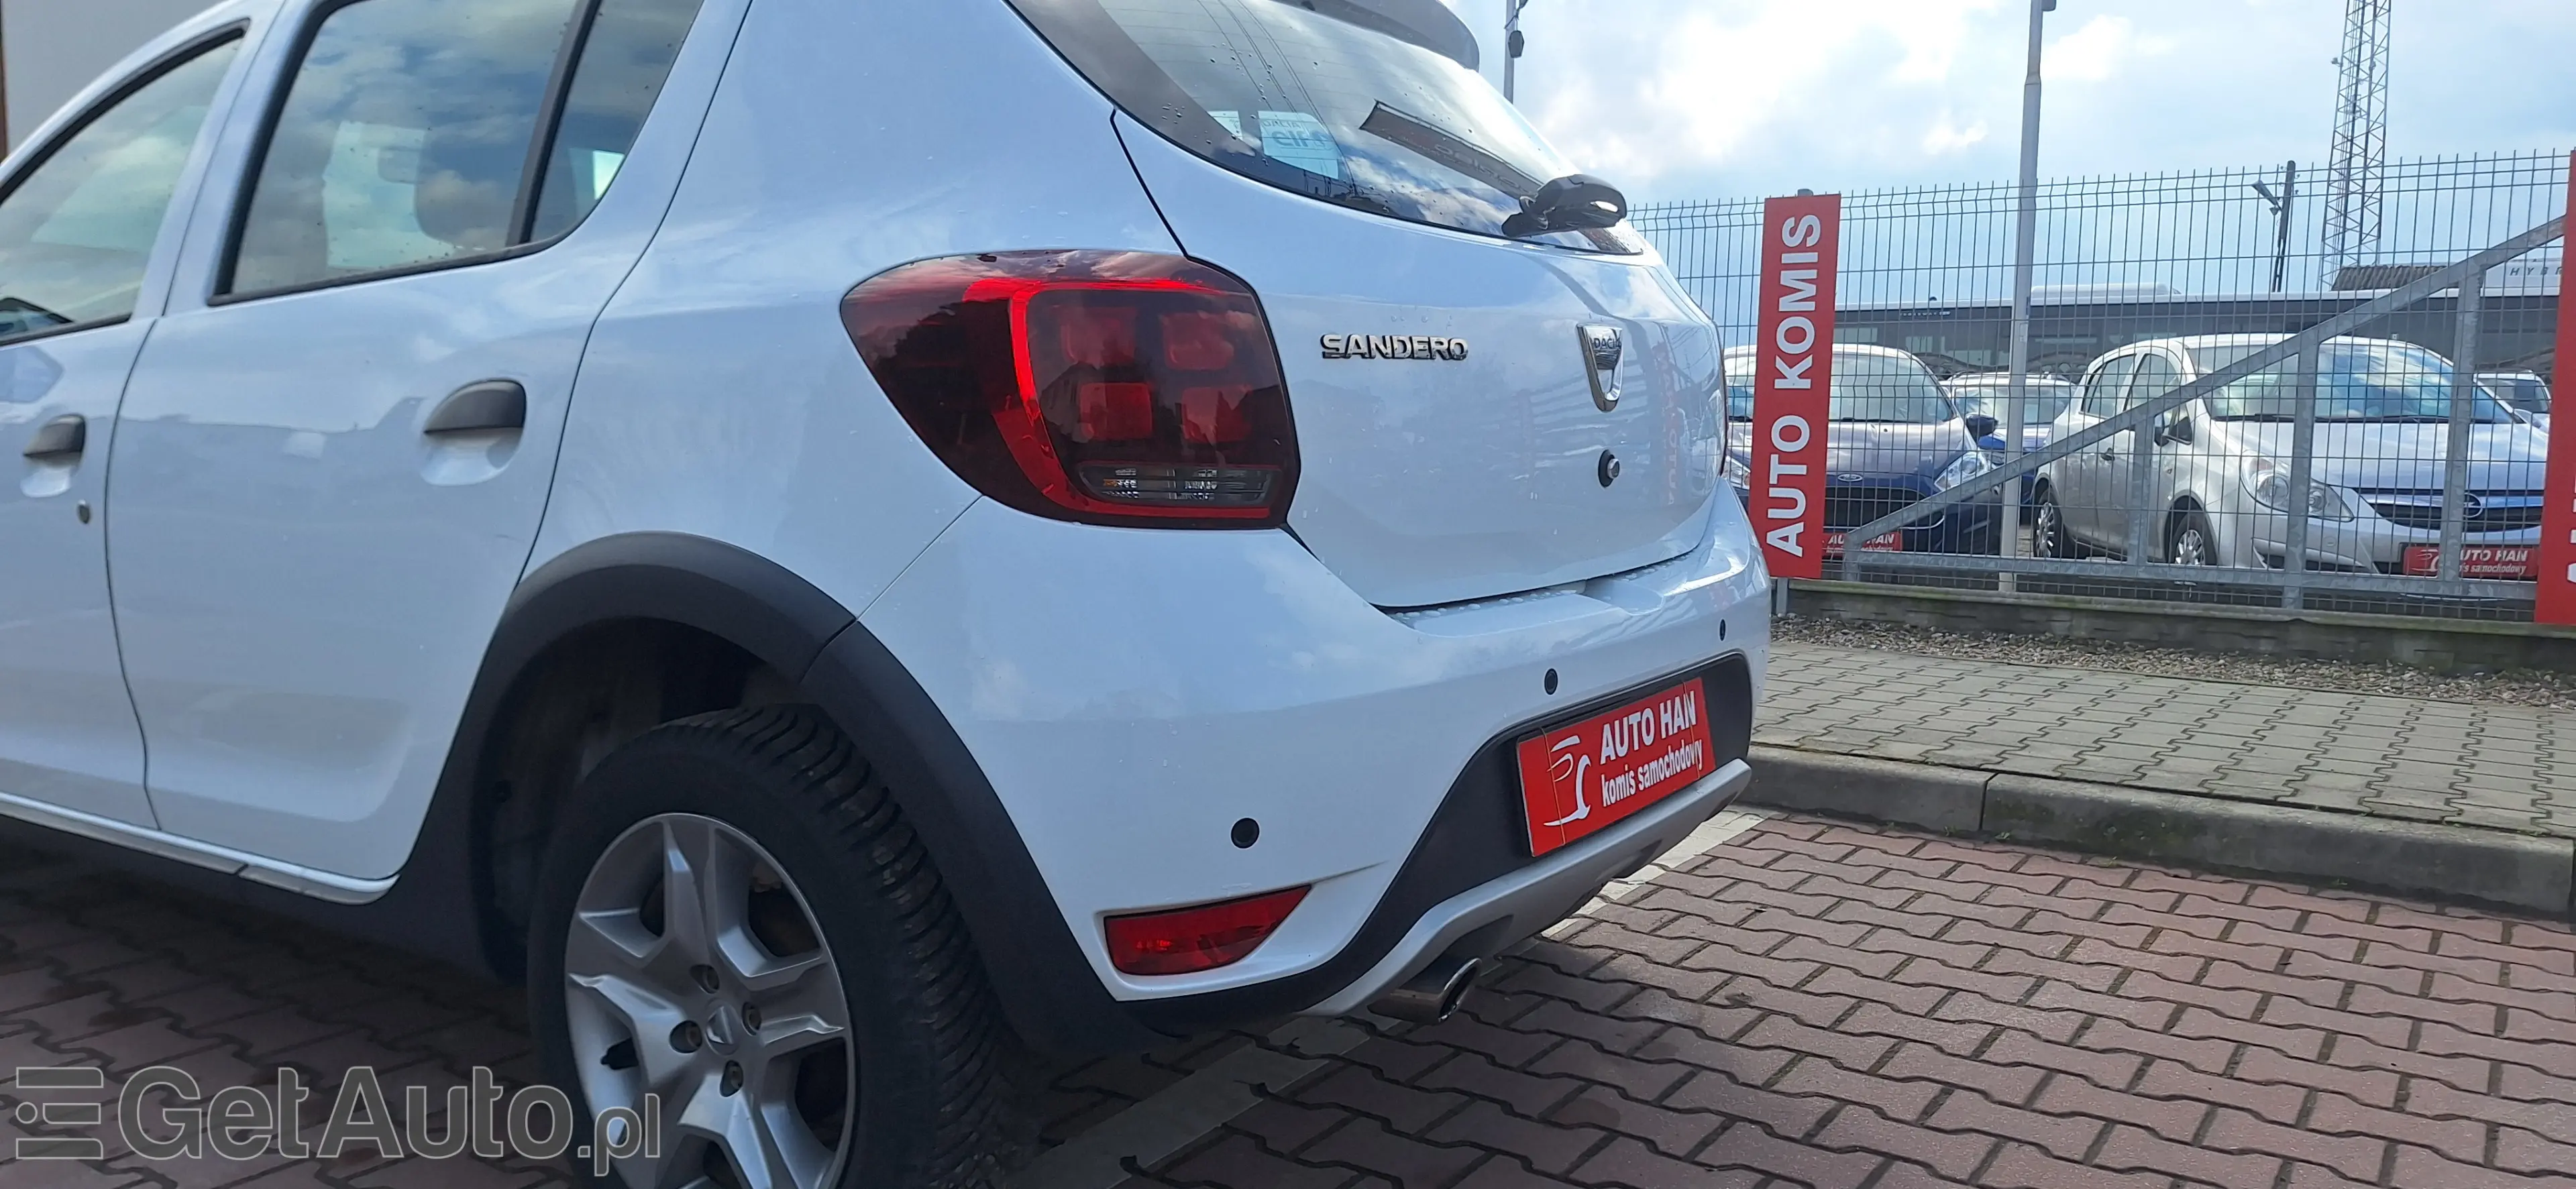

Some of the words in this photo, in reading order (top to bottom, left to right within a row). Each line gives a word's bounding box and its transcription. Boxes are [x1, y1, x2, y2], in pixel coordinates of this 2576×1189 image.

[1774, 214, 1821, 391] KOMIS
[1320, 333, 1468, 361] SANDERO
[1593, 337, 1622, 349] DACIA
[1766, 414, 1810, 558] AUTO
[2460, 550, 2491, 561] UTO
[2495, 549, 2528, 562] HAN
[1599, 707, 1655, 765] AUTO
[1659, 690, 1697, 739] HAN
[1601, 764, 1636, 807] komis
[1637, 738, 1703, 792] samochodowy
